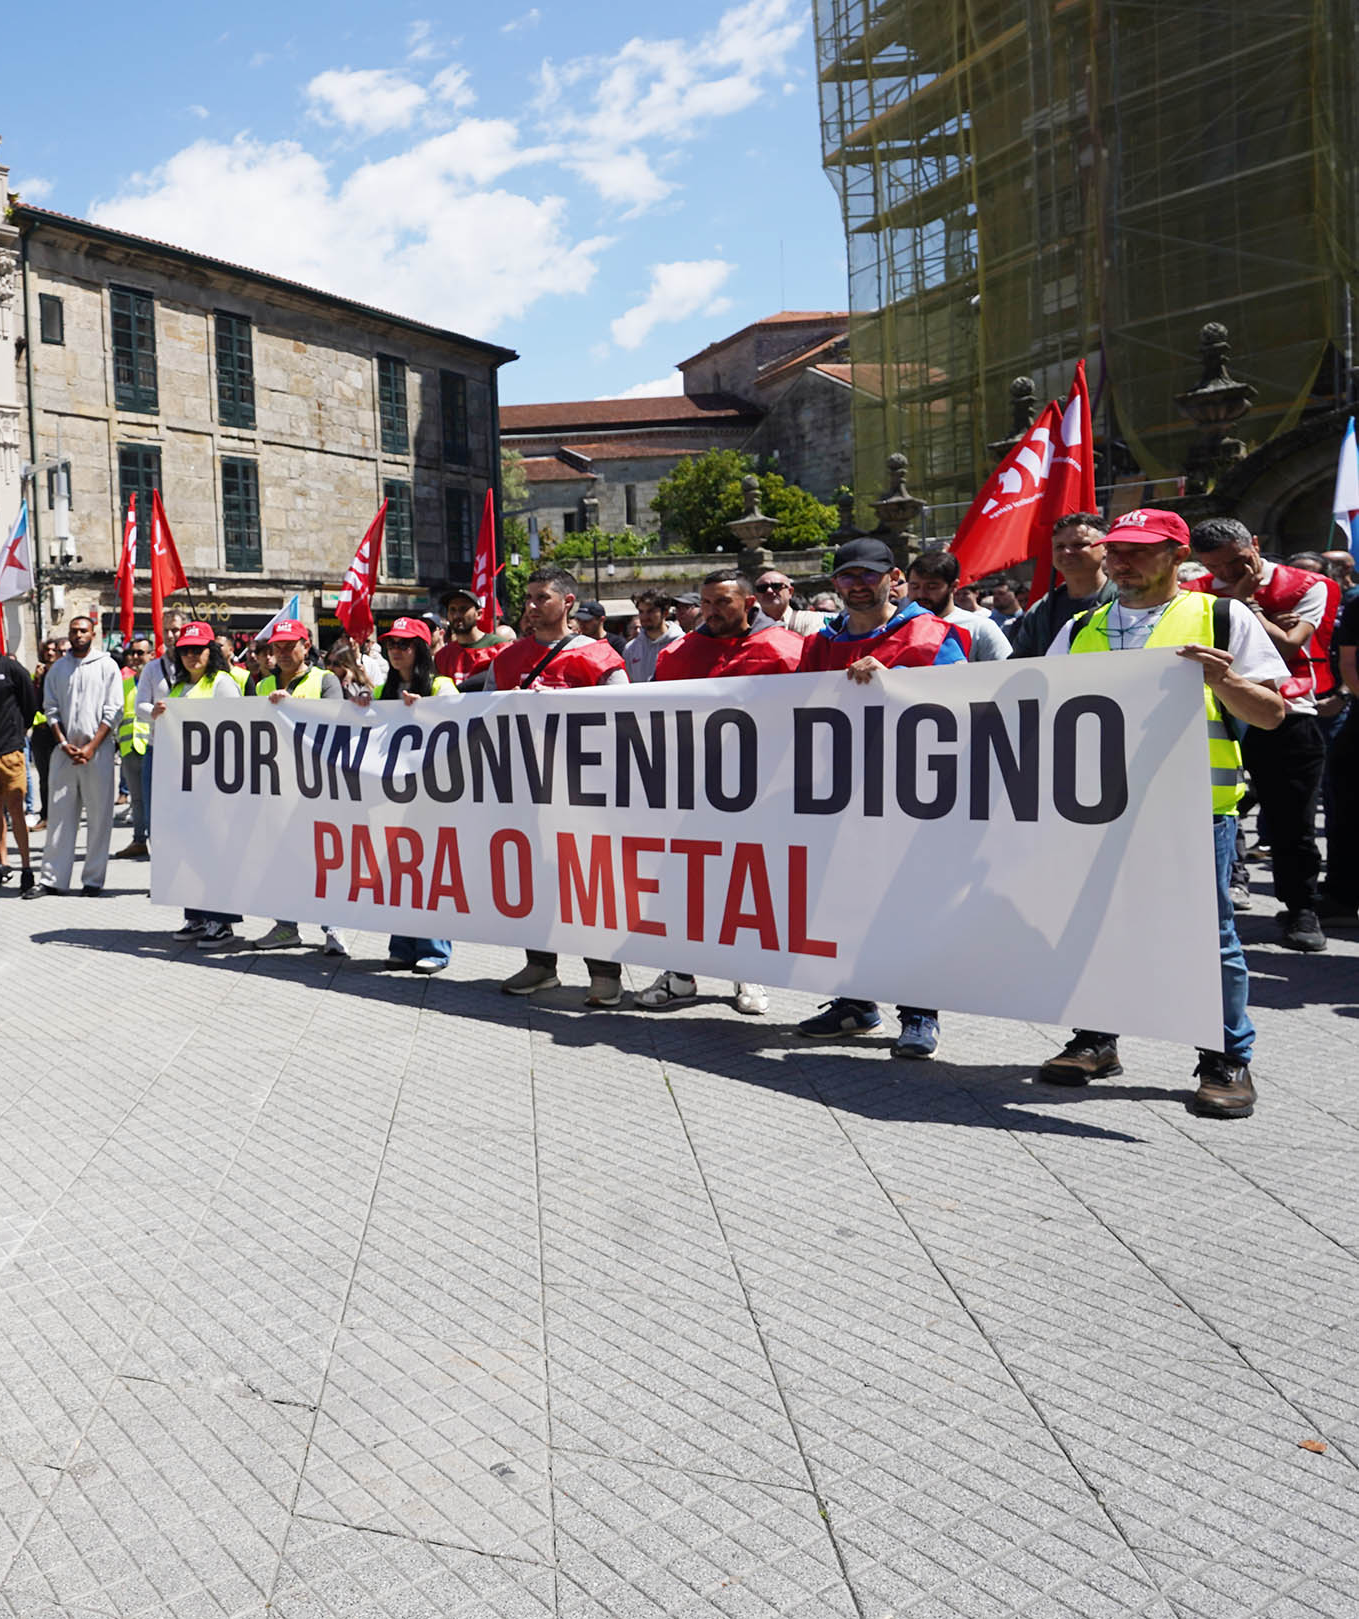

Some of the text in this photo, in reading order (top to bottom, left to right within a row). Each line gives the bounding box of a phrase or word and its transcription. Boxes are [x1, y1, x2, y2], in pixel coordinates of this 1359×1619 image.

[181, 694, 1129, 825] POR UN CONVENIO DIGNO
[313, 821, 837, 958] PARA O METAL
